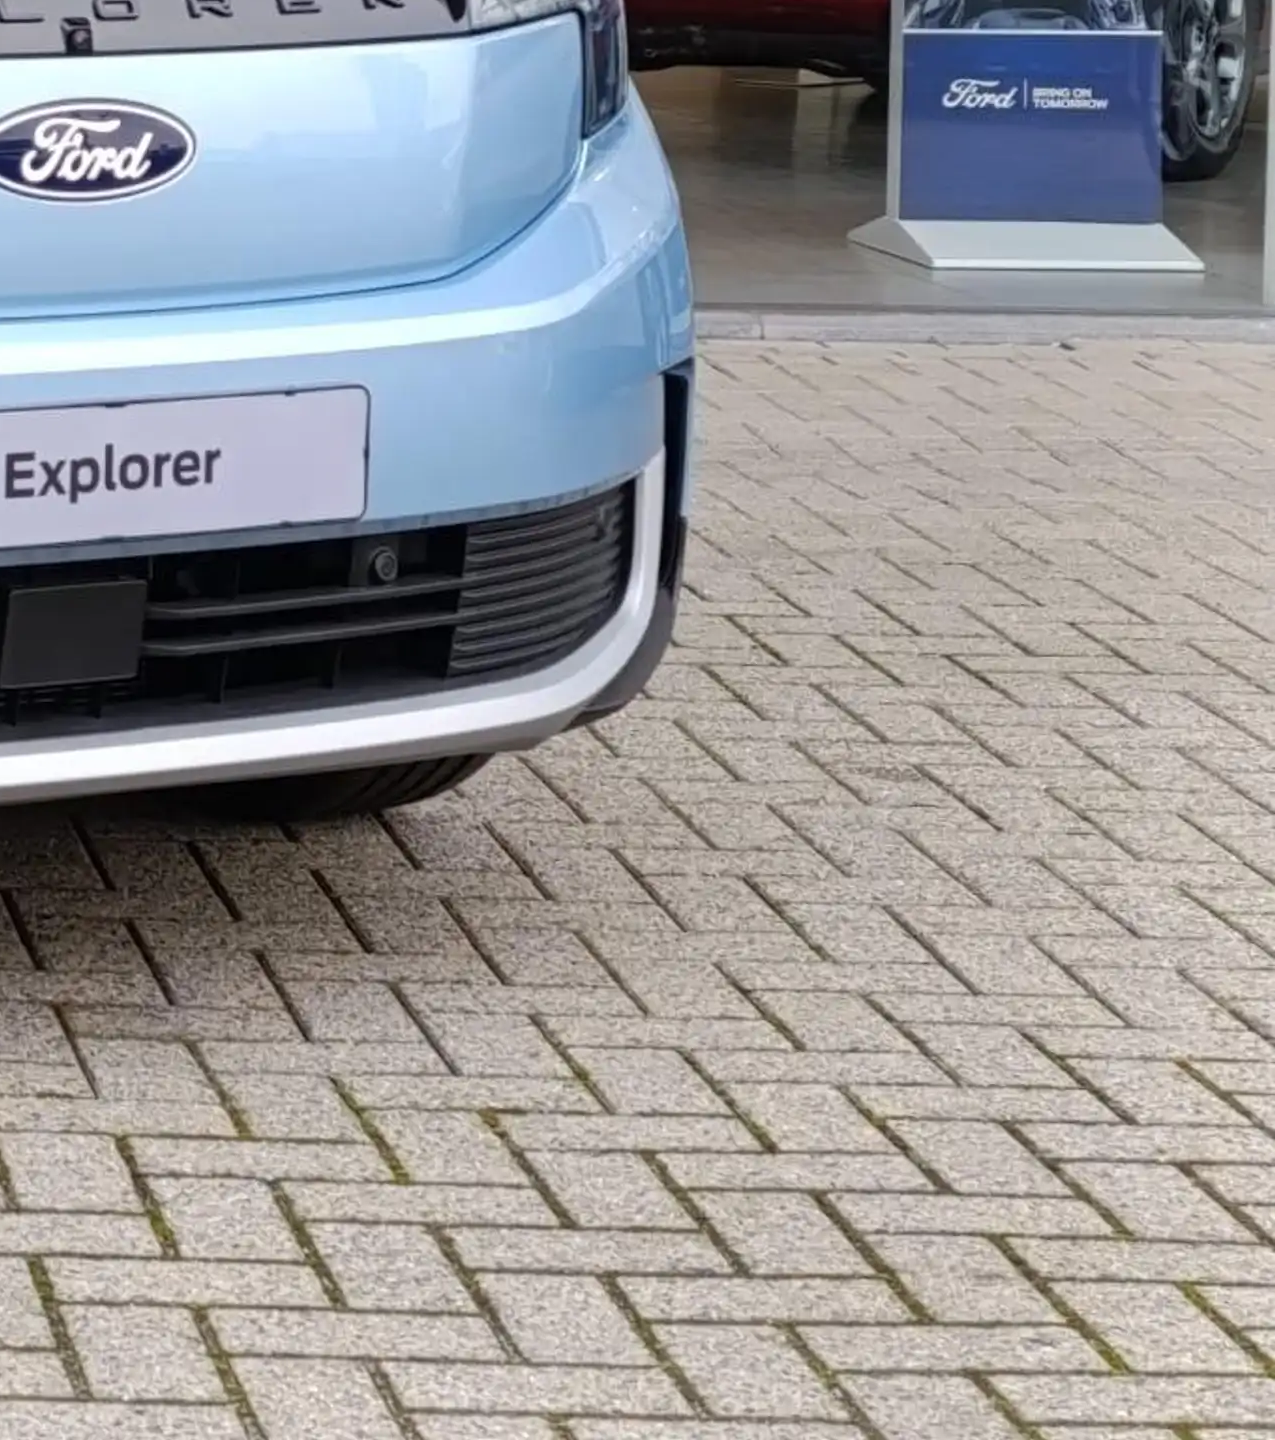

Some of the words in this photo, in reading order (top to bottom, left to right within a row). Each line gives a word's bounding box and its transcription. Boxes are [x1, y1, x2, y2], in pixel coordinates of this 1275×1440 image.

[941, 77, 1018, 109] Ford
[19, 116, 151, 182] Ford
[4, 443, 222, 504] Explorer
